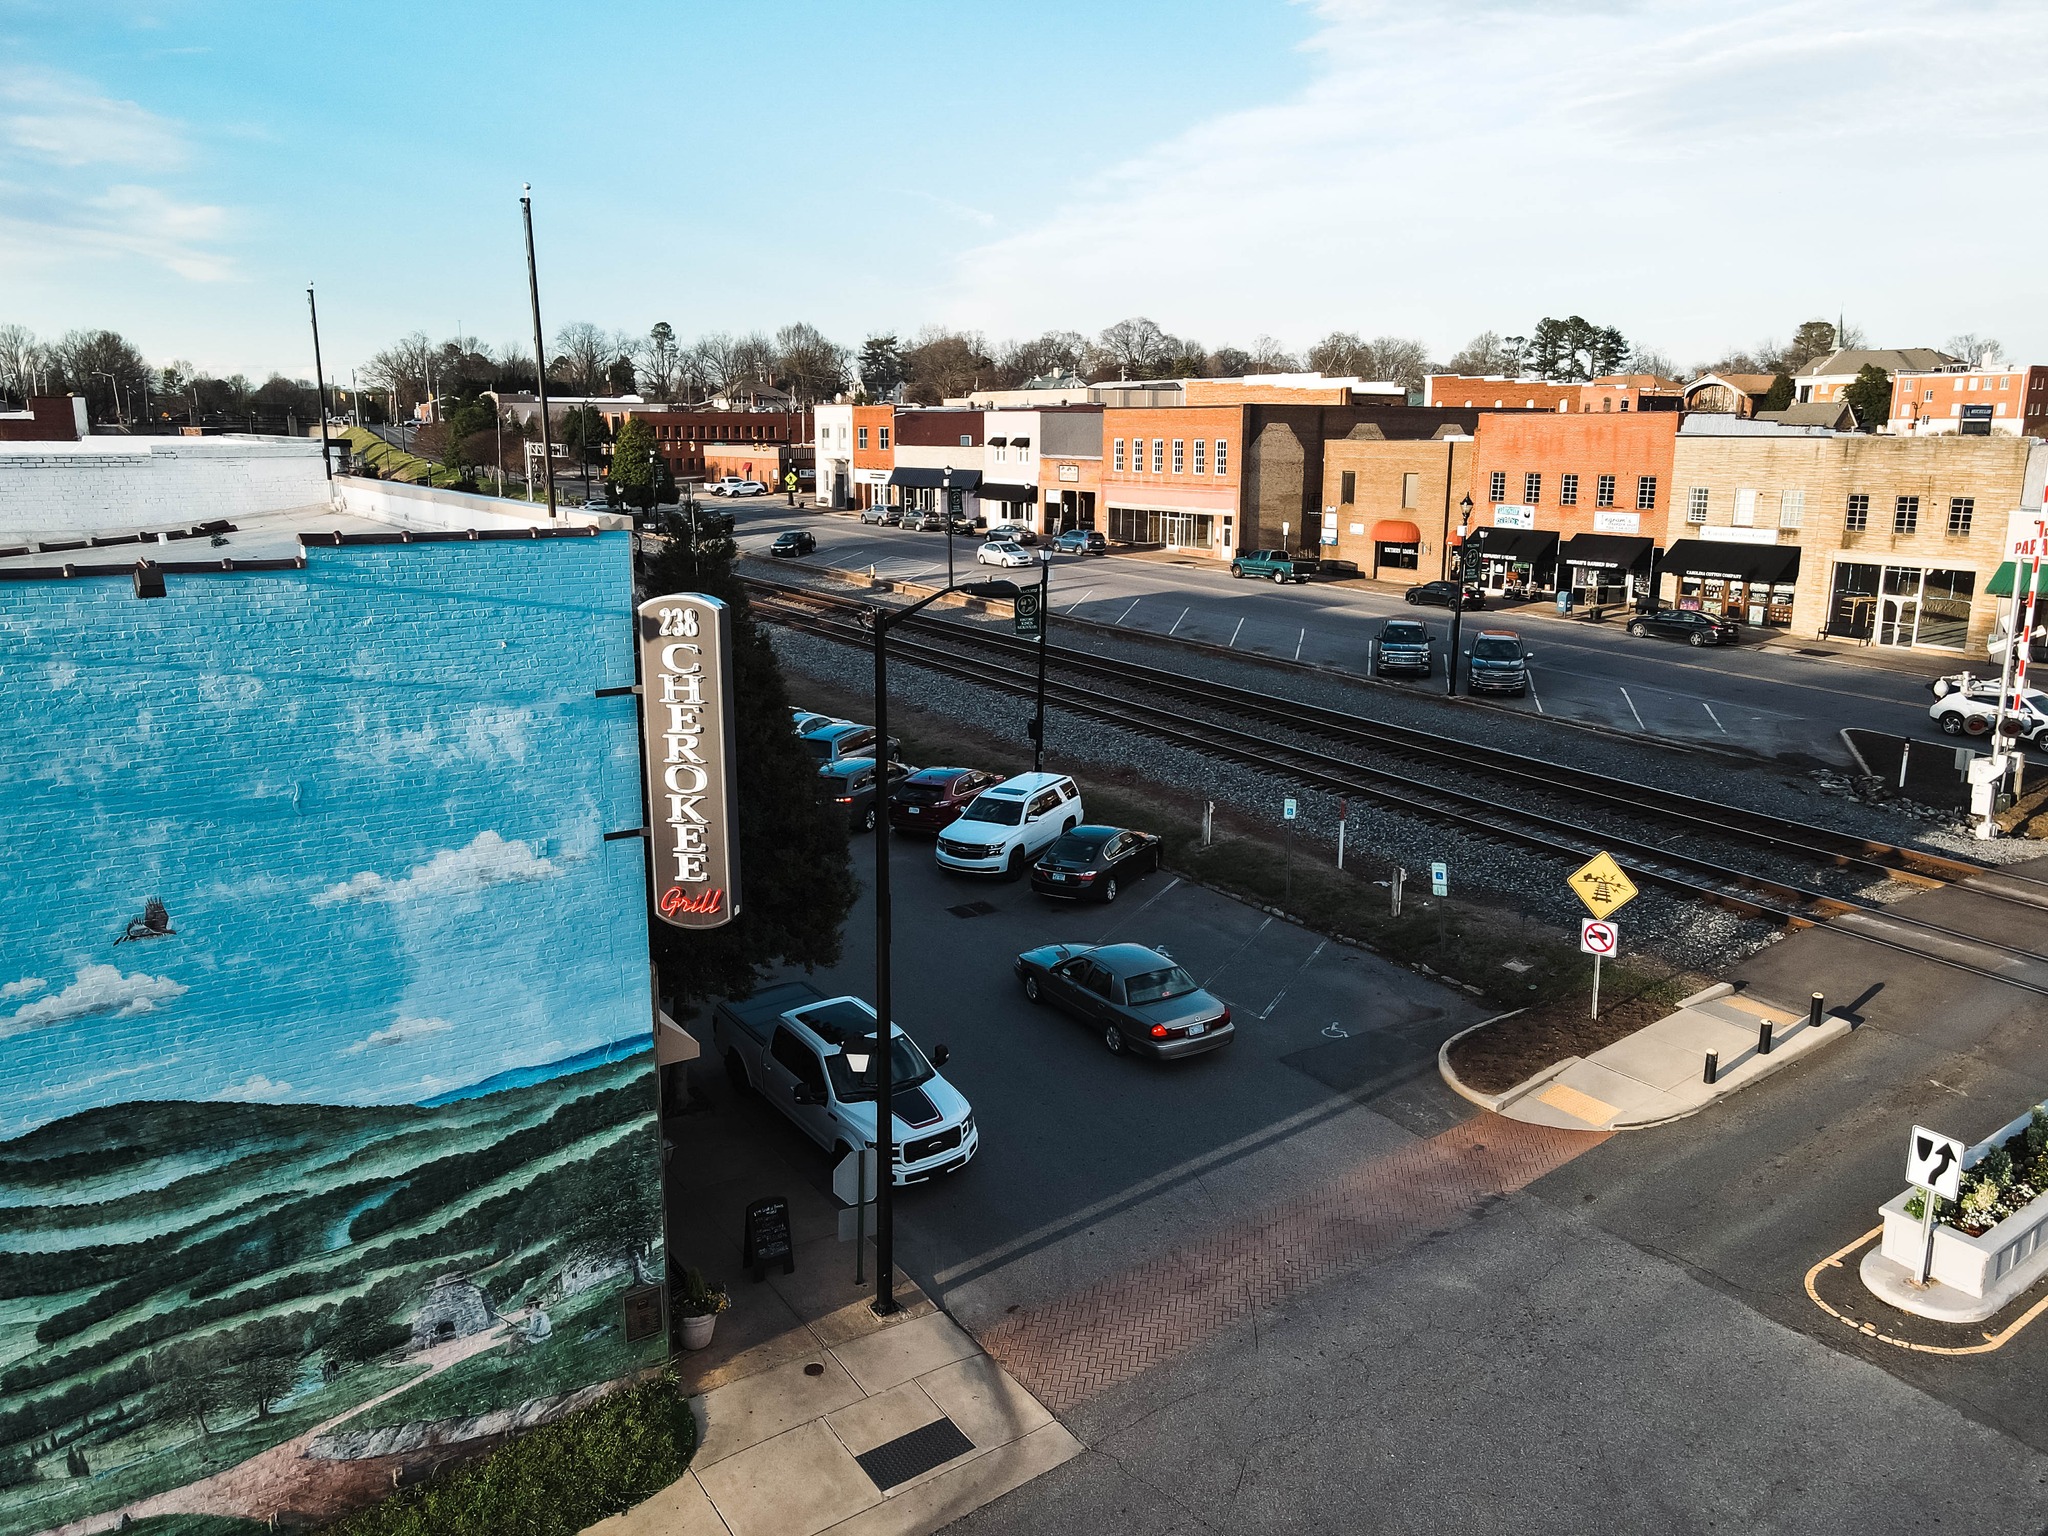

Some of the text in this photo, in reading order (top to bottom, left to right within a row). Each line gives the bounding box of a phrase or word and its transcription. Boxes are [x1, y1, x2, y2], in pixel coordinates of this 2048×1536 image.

[658, 607, 700, 638] 238
[656, 643, 712, 884] CHEROKEE
[660, 886, 722, 917] Grill
